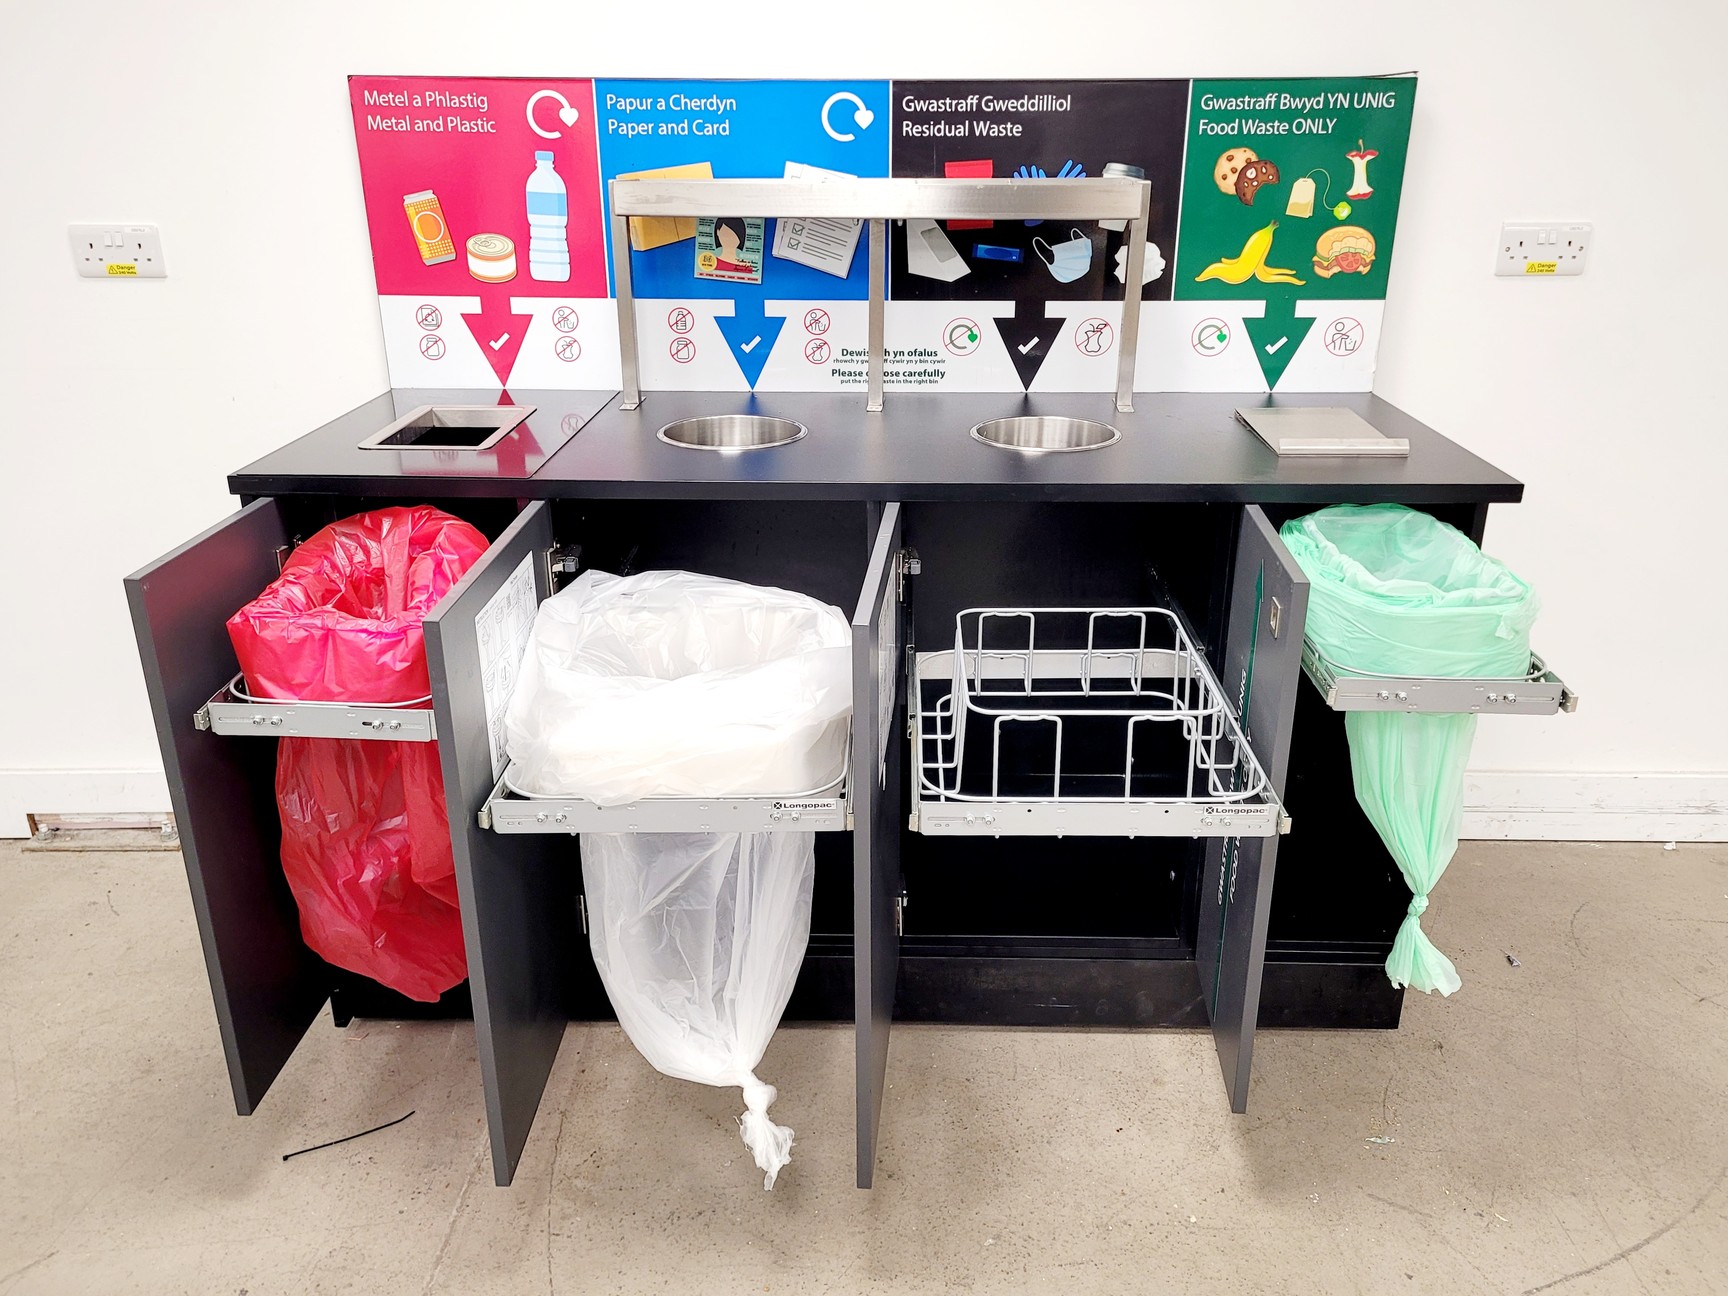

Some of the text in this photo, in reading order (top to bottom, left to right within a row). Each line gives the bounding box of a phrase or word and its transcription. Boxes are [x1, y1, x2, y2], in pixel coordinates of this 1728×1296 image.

[364, 90, 488, 112] Metel a Phlastig
[606, 94, 736, 114] Papur a Cherdyn
[902, 95, 1071, 112] Gwastraff Gweddilliol
[1200, 92, 1396, 114] Gwastraff Bwyd YN UNIG
[368, 115, 496, 132] Metal and Plastic
[608, 119, 730, 138] Paper and Card
[902, 120, 1022, 136] Residual Waste
[1198, 118, 1337, 136] Food Waste ONLY
[892, 350, 905, 359] yn
[907, 348, 938, 357] ofalus
[832, 368, 863, 377] Please
[902, 368, 946, 379] carefully
